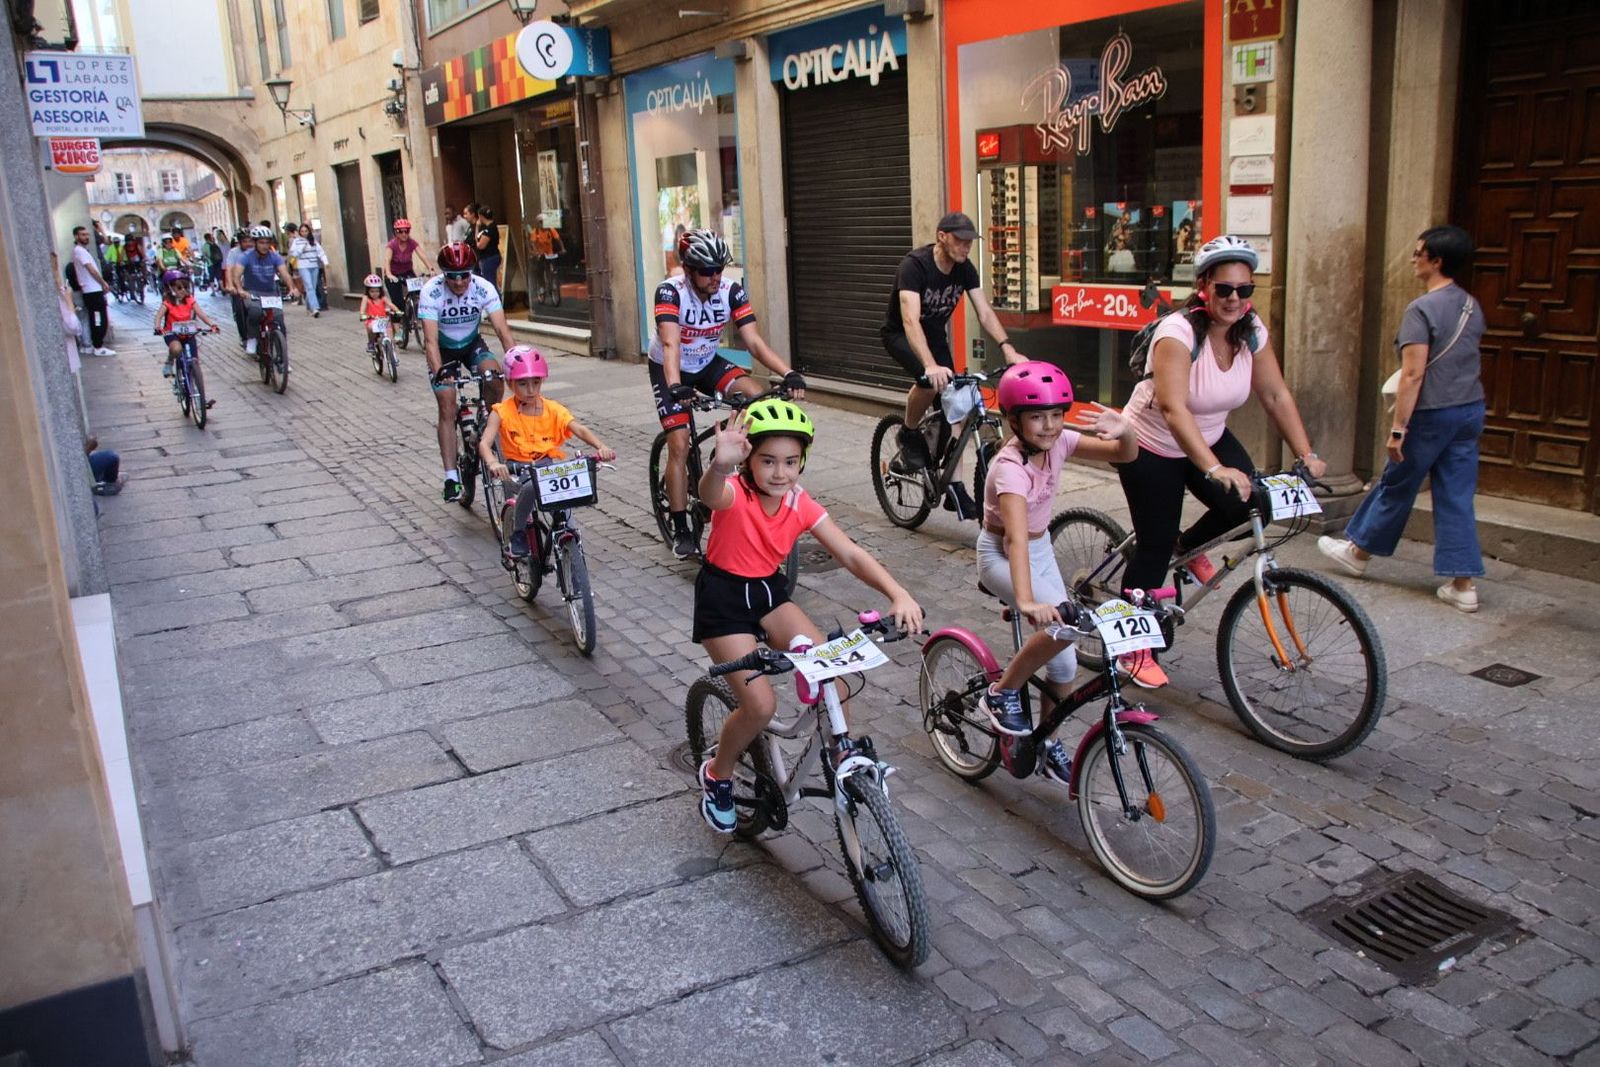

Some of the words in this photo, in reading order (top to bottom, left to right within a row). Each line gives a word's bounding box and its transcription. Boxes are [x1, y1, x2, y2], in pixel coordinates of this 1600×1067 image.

[64, 60, 127, 71] LOPEZ
[66, 74, 129, 84] LABAJOS
[30, 87, 109, 103] GESTORÍA
[33, 107, 109, 124] ASESORÍA
[51, 141, 97, 151] BURGER
[53, 151, 99, 165] KING
[685, 309, 726, 325] UAE
[548, 475, 580, 492] 301
[1281, 489, 1309, 505] 121
[1114, 616, 1151, 638] 120
[813, 650, 866, 669] 154
